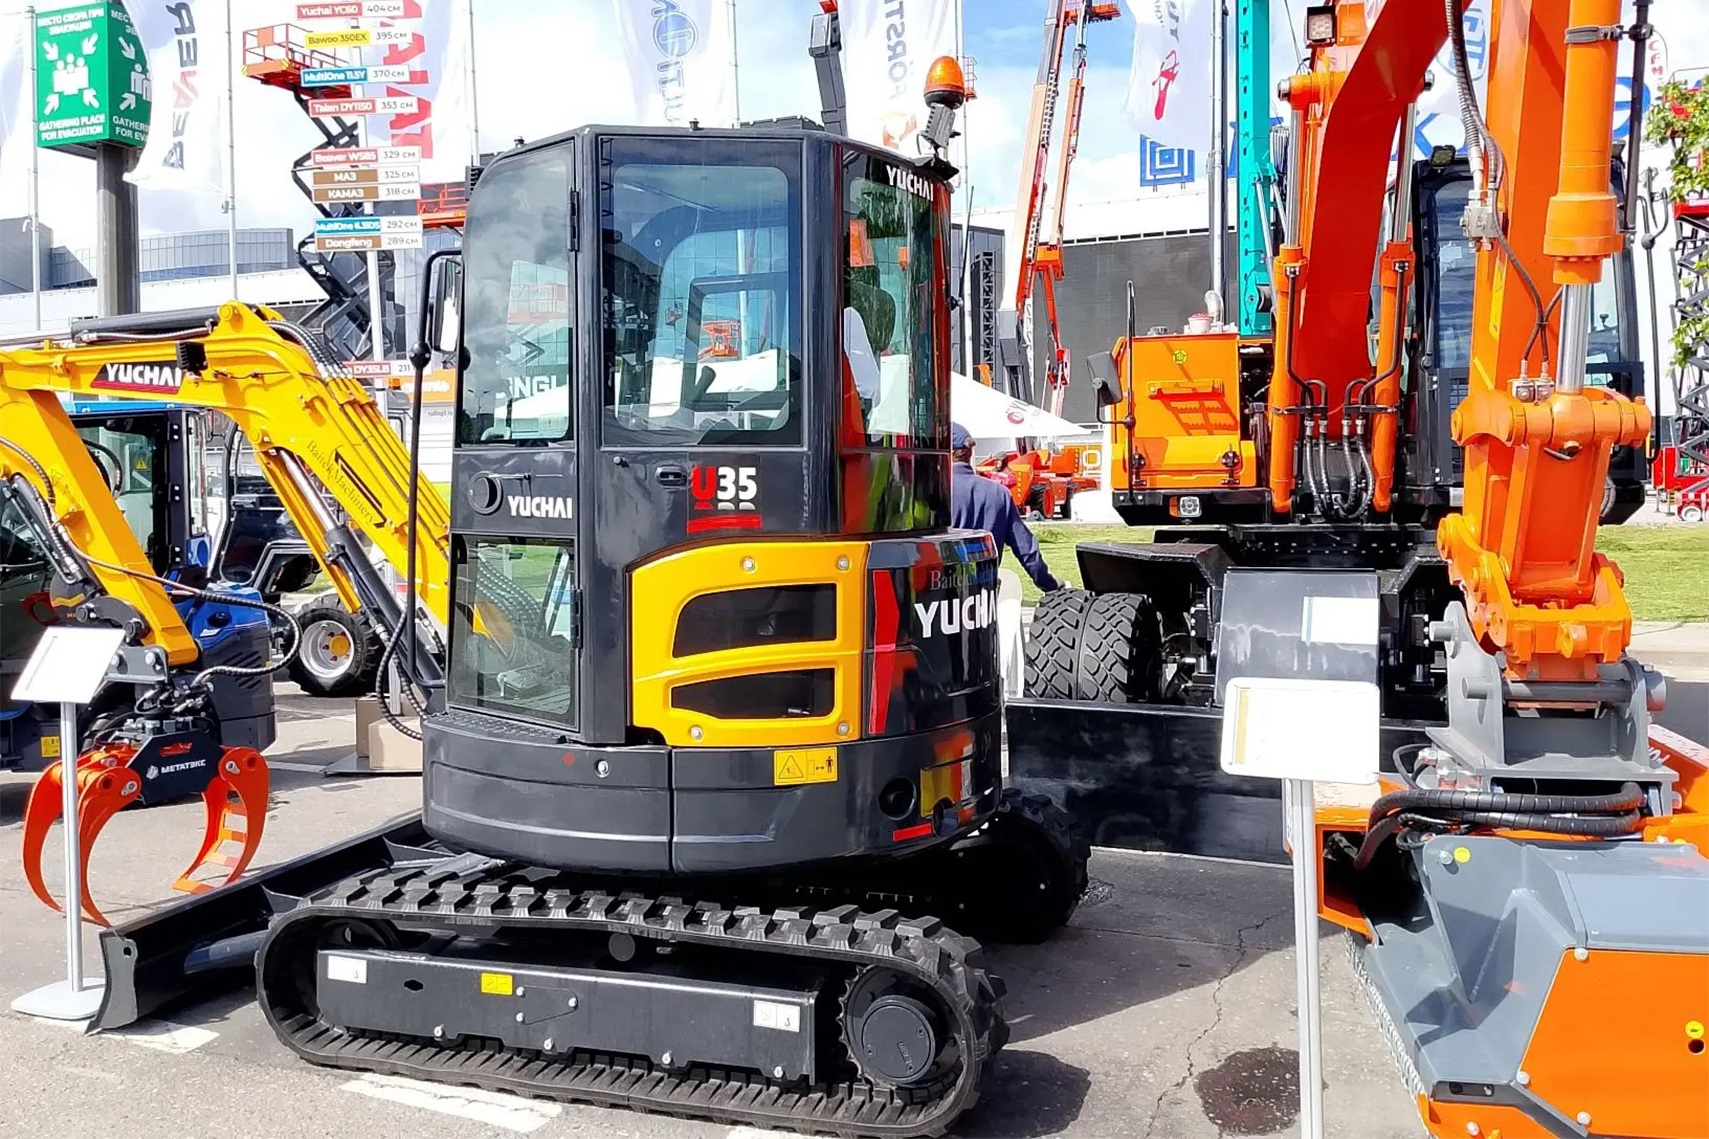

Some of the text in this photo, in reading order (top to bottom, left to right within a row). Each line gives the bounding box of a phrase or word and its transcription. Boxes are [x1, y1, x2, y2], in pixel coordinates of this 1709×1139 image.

[300, 6, 333, 16] Yuchai
[367, 4, 387, 13] 404
[110, 9, 132, 23] МЕС
[308, 32, 368, 45] Bawoo 350EX
[376, 31, 393, 40] 395
[373, 69, 391, 79] 370
[381, 101, 398, 110] 353
[38, 112, 106, 131] GATHERING PLACE
[41, 124, 104, 141] FOR EVACUATION
[115, 126, 134, 139] FOR
[383, 150, 400, 159] 329
[384, 170, 400, 179] 325
[885, 164, 934, 202] YUCHAI
[385, 188, 401, 196] 318
[386, 220, 403, 229] 292
[325, 238, 373, 248] Dongfeng
[387, 237, 404, 245] 289
[105, 363, 182, 387] YUCHAI
[691, 465, 757, 500] U35
[507, 495, 573, 519] YUCHAI
[914, 587, 998, 638] YUCHA
